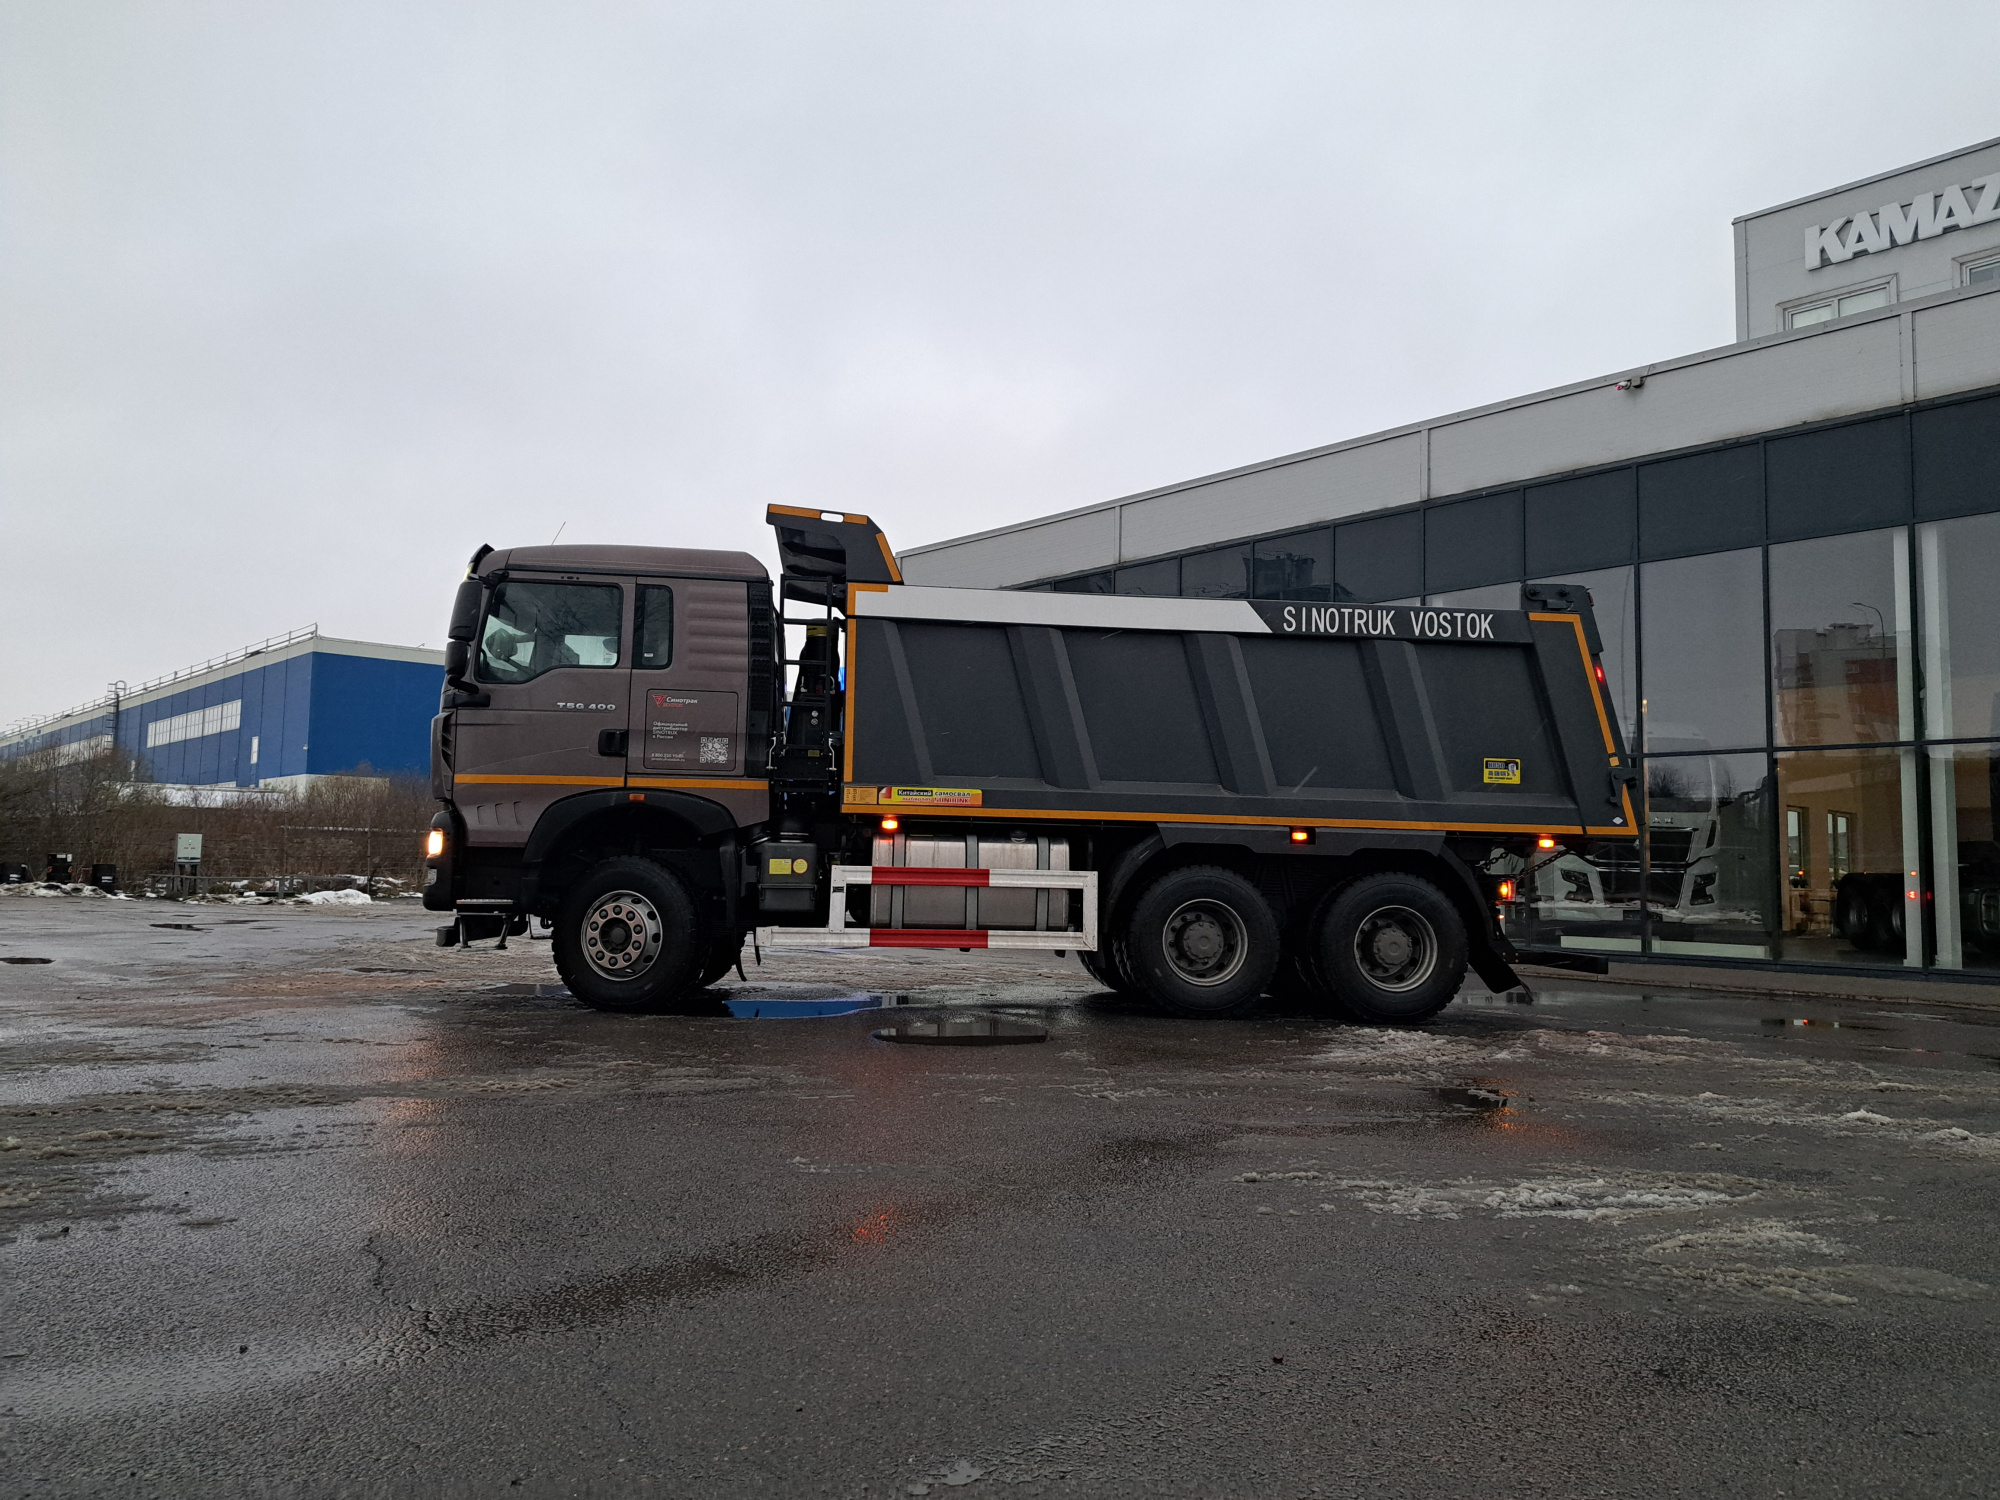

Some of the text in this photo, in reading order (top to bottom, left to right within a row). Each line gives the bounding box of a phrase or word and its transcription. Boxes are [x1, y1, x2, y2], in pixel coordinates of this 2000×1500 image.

[1804, 171, 2000, 272] KAMAZ
[1283, 606, 1494, 639] SINOTRUK VOSTOK
[588, 703, 616, 711] 400
[666, 696, 698, 704] Синотрак
